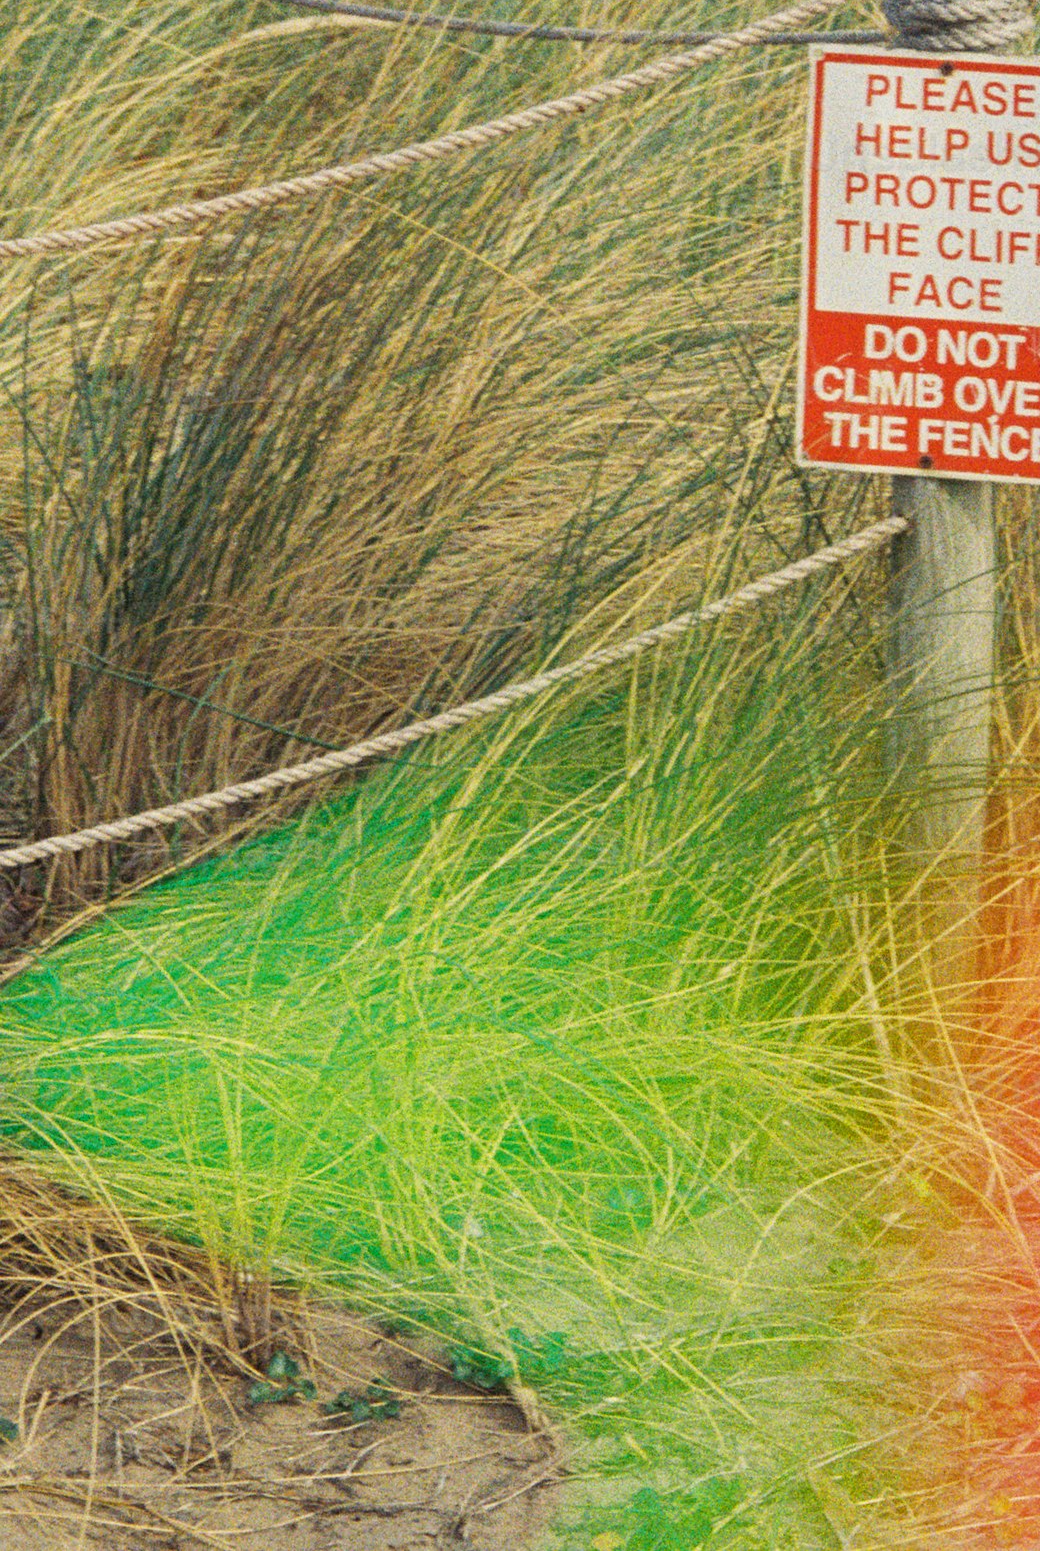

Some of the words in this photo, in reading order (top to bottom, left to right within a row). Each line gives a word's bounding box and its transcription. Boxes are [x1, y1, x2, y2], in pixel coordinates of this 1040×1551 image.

[866, 74, 1037, 118] PLEASE
[855, 122, 970, 161] HELP
[836, 219, 920, 257] THE
[888, 272, 1003, 312] FACE
[864, 323, 928, 363] DO
[937, 329, 1026, 371] NOT
[813, 365, 944, 409] CLIMB
[823, 411, 908, 452] THE
